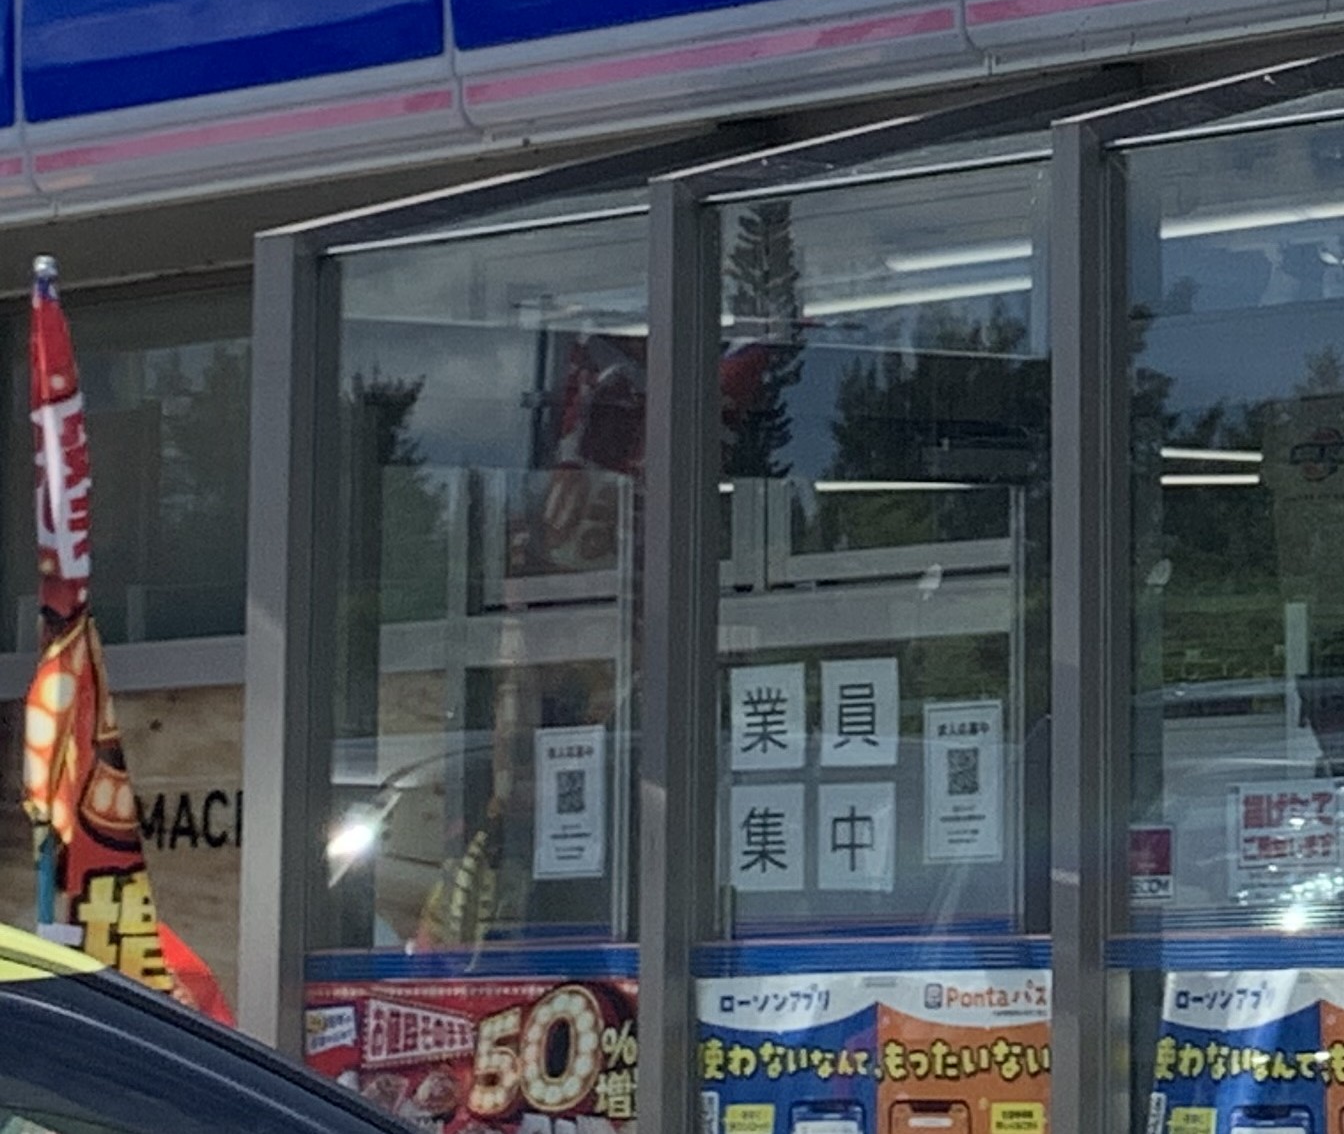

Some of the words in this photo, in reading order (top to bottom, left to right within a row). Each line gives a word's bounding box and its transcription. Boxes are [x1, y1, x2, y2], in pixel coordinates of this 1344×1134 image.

[134, 790, 243, 850] MAC
[720, 982, 831, 1014] ローソンアプリ
[945, 978, 1047, 1009] Pontaパス
